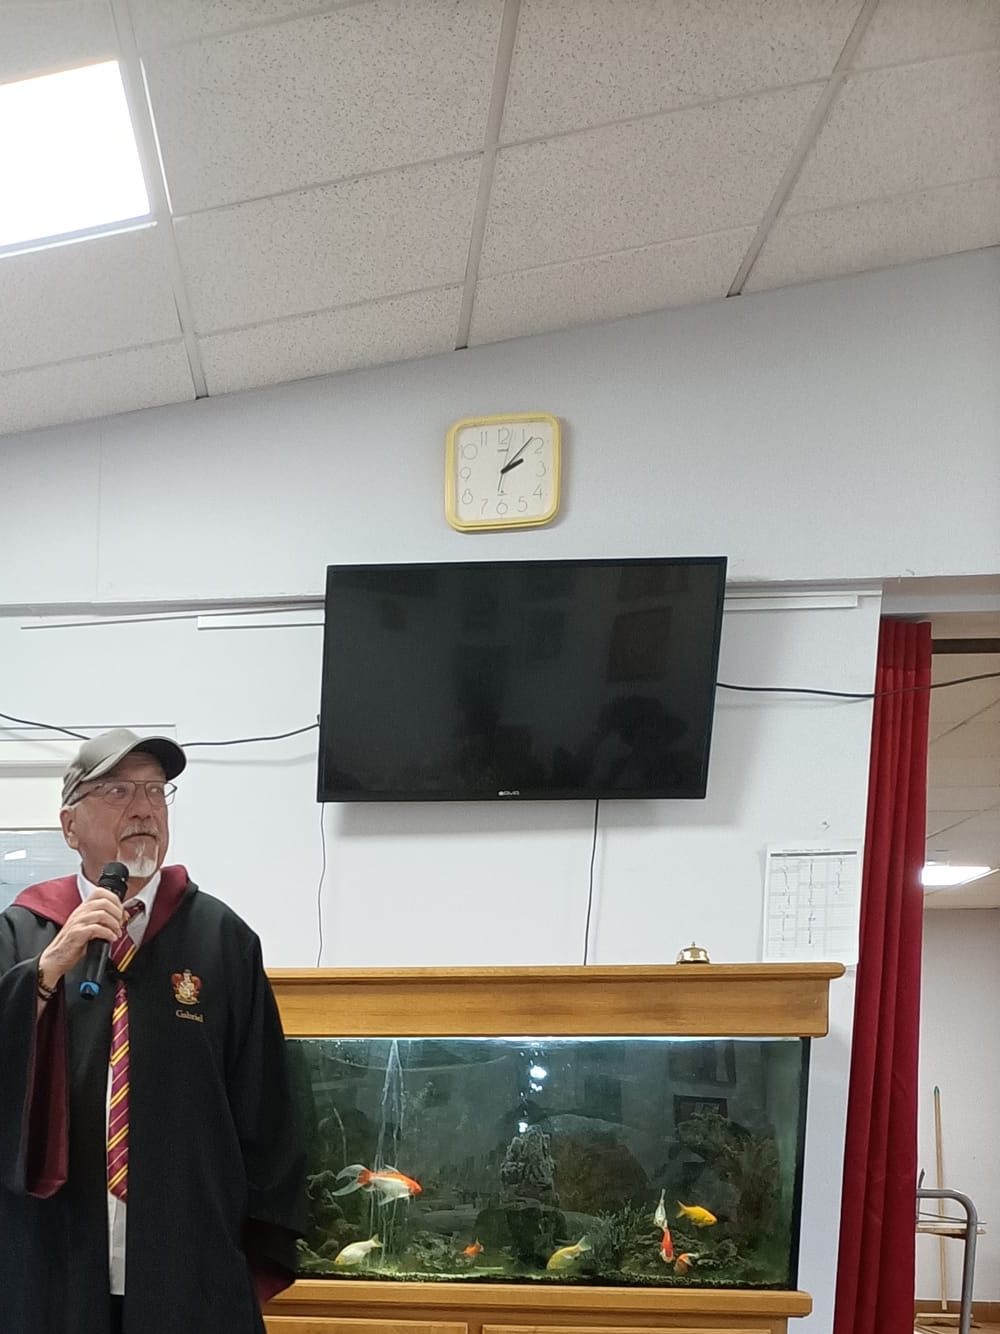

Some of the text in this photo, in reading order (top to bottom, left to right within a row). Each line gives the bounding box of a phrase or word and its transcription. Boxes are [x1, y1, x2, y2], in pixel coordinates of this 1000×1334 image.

[480, 430, 488, 447] 11
[497, 427, 510, 445] 12
[460, 442, 479, 461] 10
[533, 437, 545, 455] 2
[459, 466, 472, 481] 9
[535, 461, 546, 478] 3
[461, 488, 474, 505] 8
[532, 483, 543, 500] 4
[480, 498, 489, 515] 7
[496, 499, 509, 516] 6
[516, 496, 528, 513] 5
[175, 1009, 204, 1023] Gabriel
